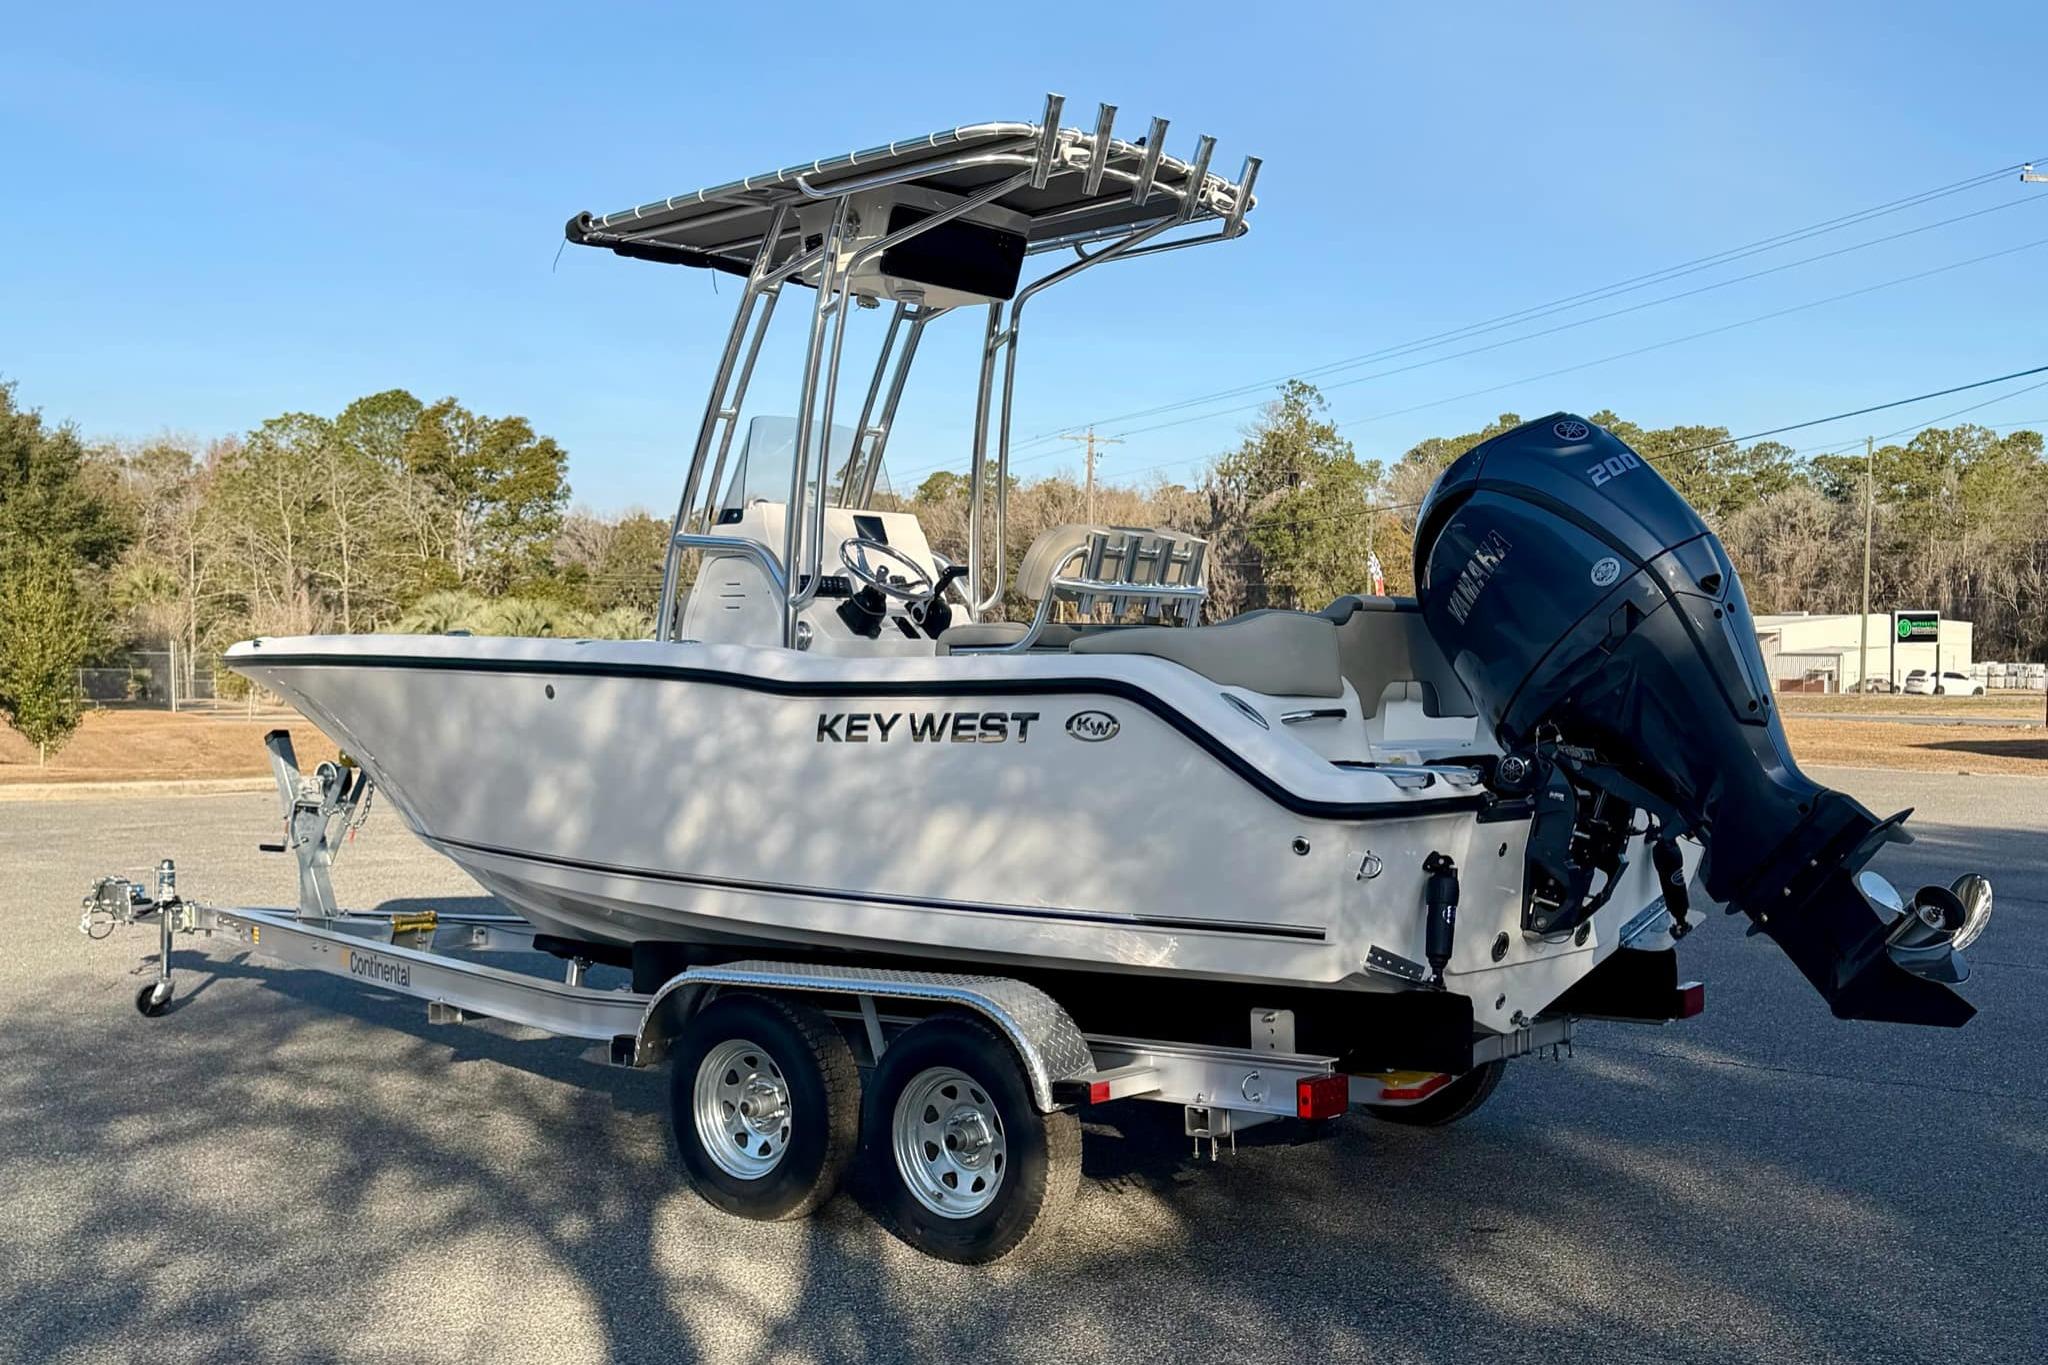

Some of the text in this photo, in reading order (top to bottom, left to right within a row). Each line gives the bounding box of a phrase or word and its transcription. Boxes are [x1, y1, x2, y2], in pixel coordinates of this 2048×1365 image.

[1587, 453, 1640, 487] 200
[816, 712, 1040, 743] KEY WEST
[350, 951, 410, 987] Continental
